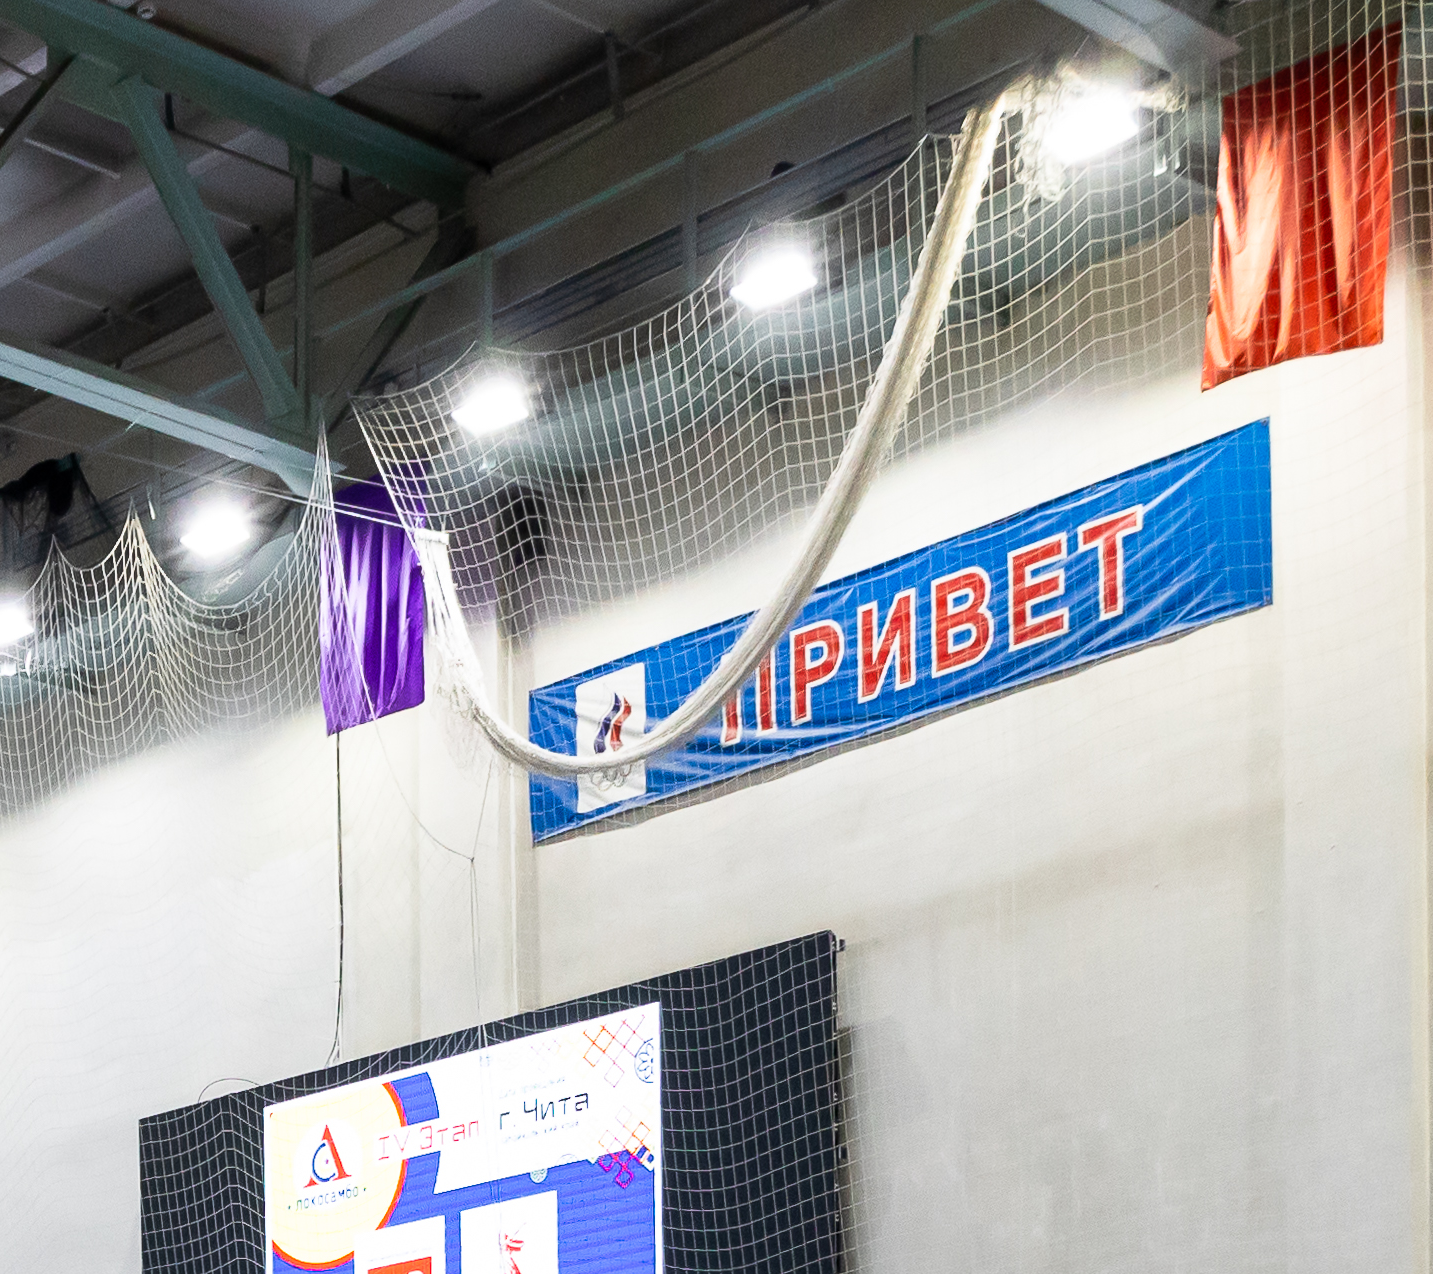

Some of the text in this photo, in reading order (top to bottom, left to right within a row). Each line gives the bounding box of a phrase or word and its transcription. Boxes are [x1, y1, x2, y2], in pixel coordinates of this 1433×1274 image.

[723, 504, 1143, 747] ПРИВЕТ
[523, 1092, 589, 1122] Чита
[420, 1120, 480, 1150] Этап
